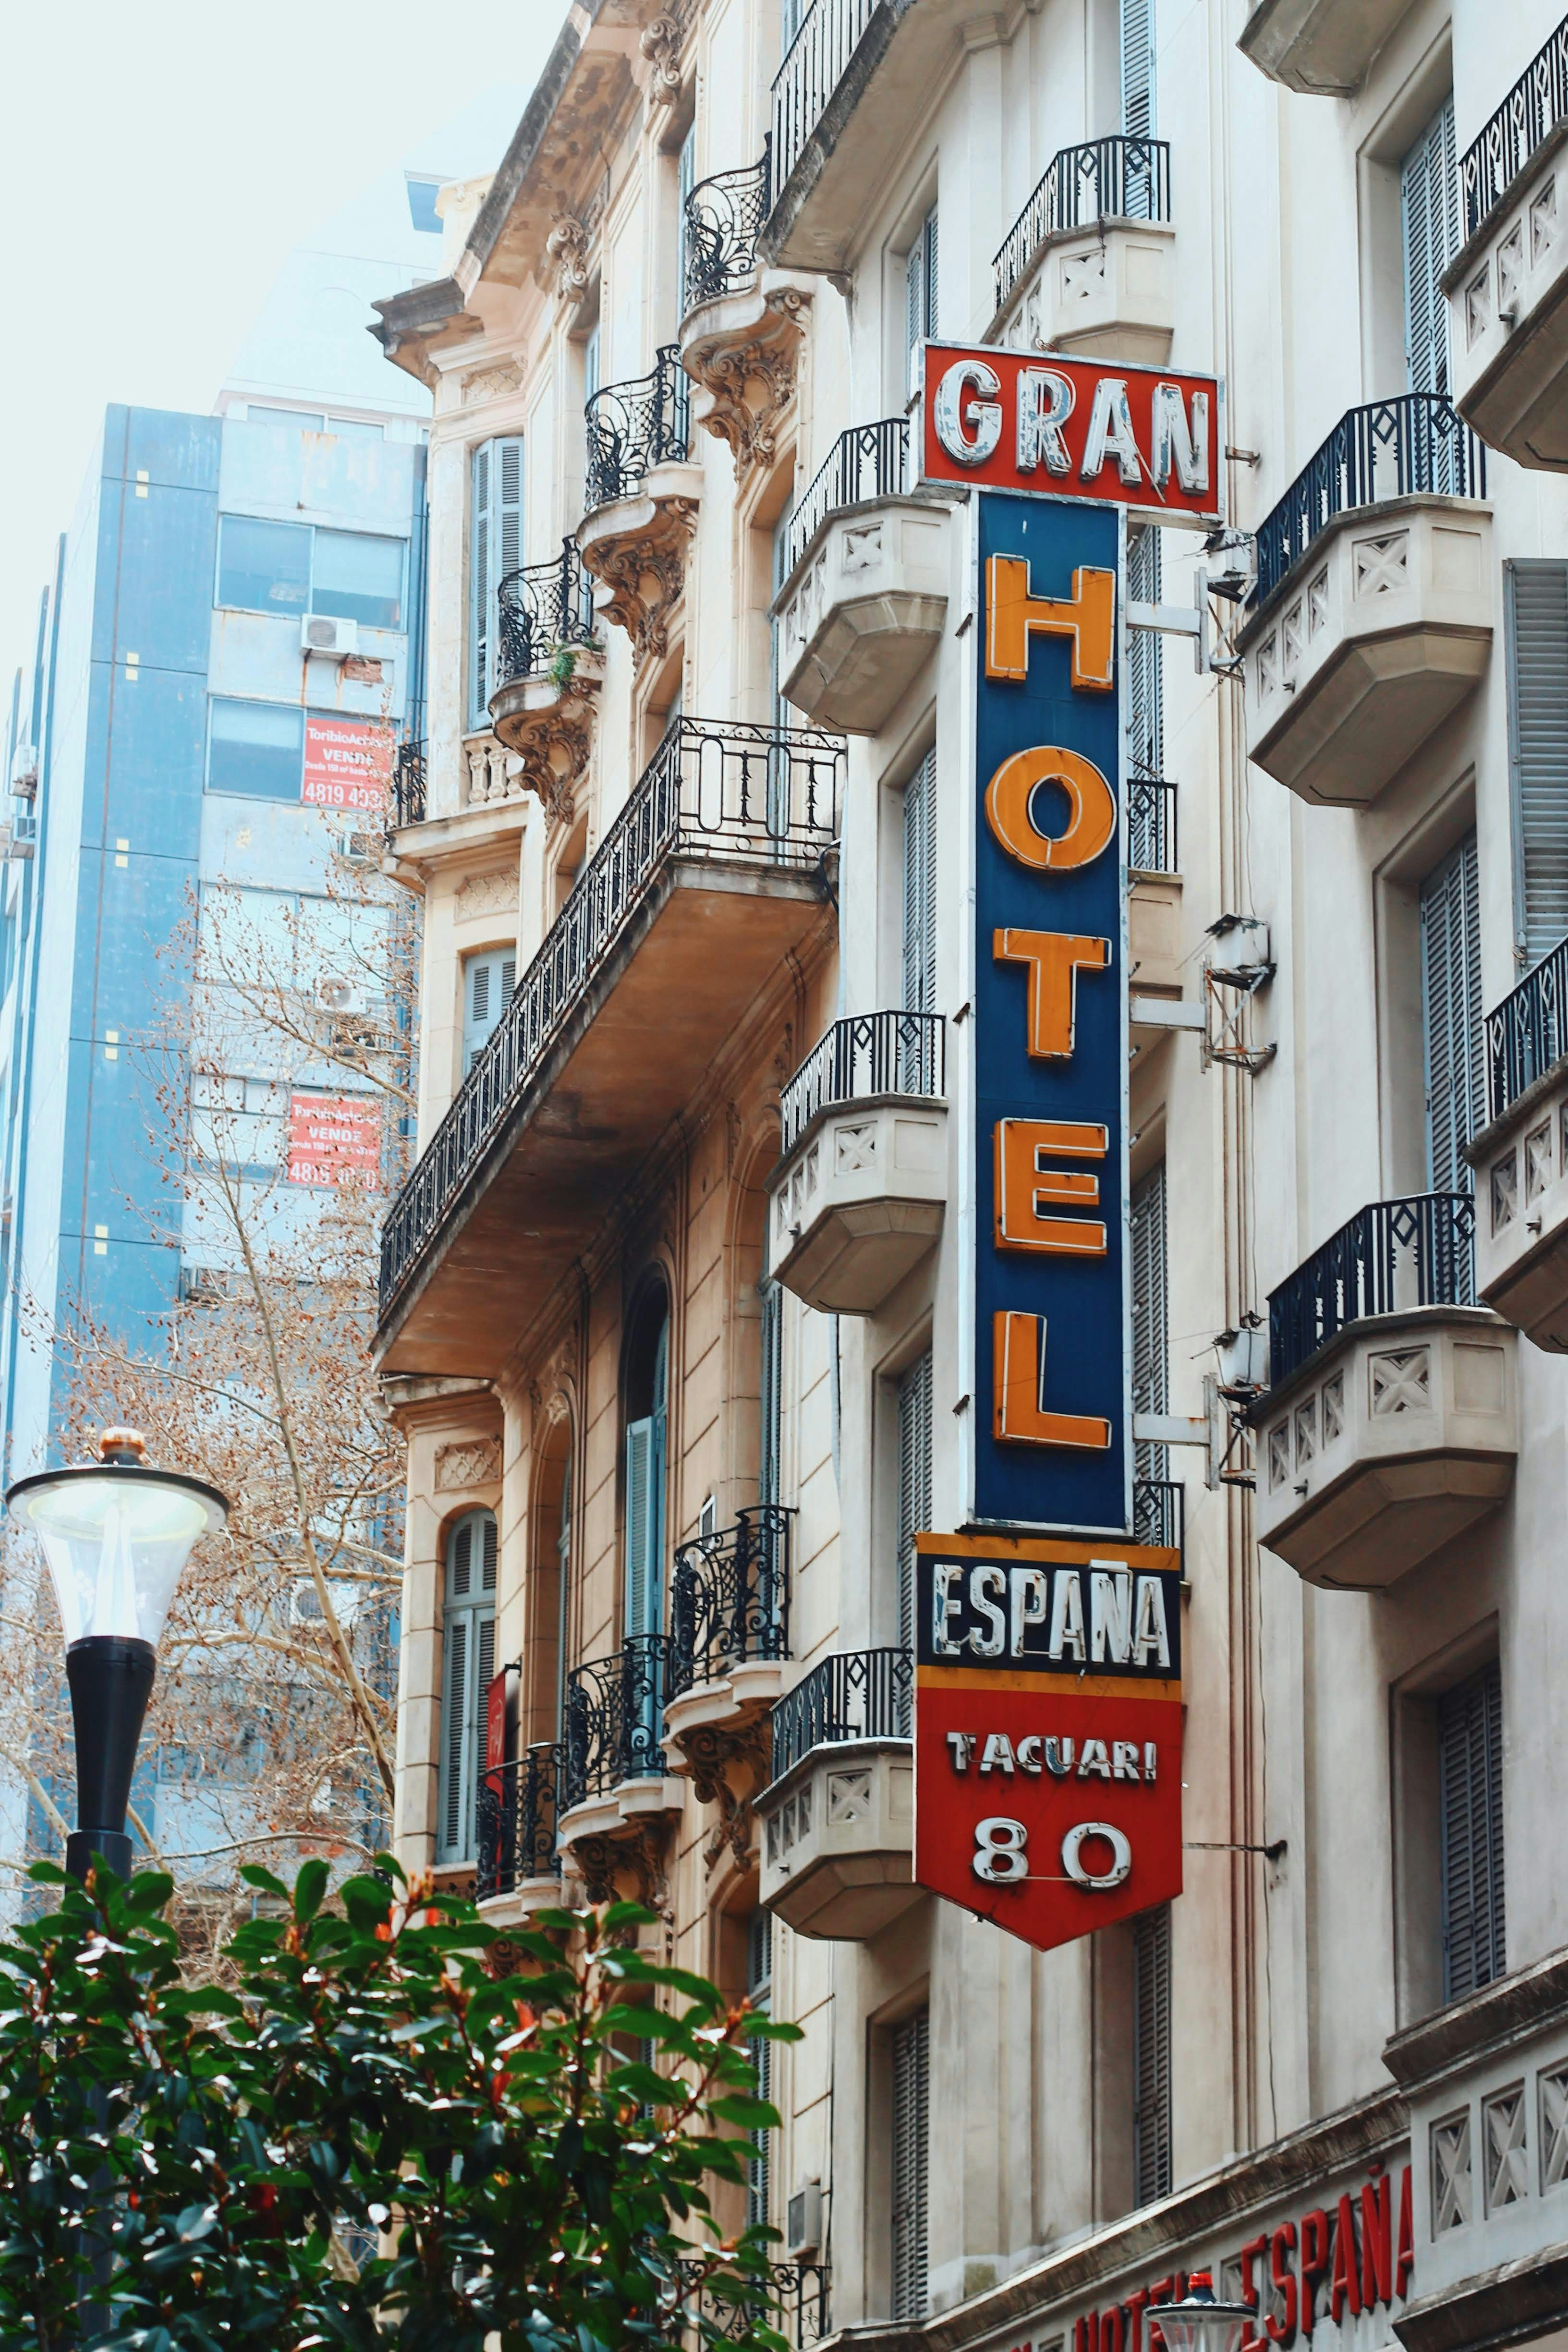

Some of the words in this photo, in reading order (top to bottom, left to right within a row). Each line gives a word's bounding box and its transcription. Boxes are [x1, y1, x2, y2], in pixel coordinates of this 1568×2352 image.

[934, 359, 1209, 495] GRAN
[305, 782, 344, 804] 4819
[984, 552, 1118, 1451] HOTEL
[309, 1126, 361, 1143] VENDE
[291, 1162, 329, 1184] 4819
[933, 1559, 1171, 1668] ESPAÑA
[947, 1732, 1156, 1780] TACUARI
[972, 1817, 1132, 1888] 80
